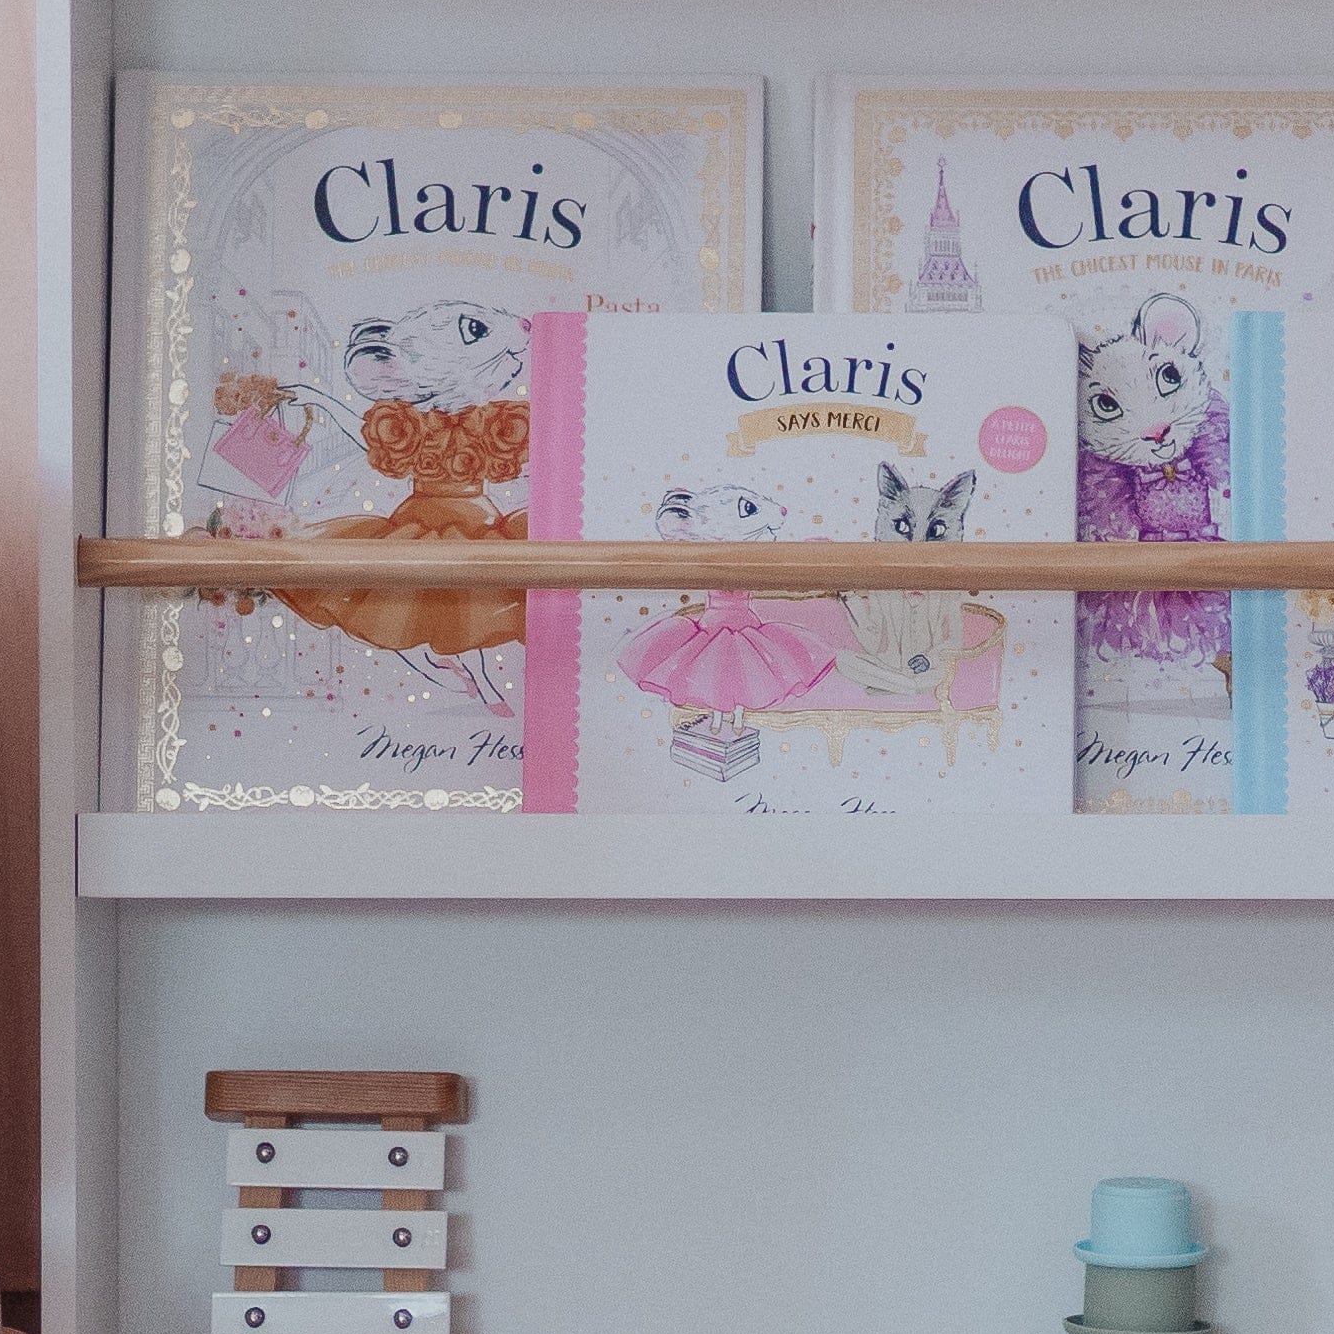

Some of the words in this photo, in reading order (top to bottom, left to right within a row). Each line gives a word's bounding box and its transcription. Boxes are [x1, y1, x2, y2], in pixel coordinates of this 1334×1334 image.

[313, 158, 588, 249] Claris
[1017, 163, 1293, 254] Claris
[1033, 264, 1064, 284] THE
[1146, 254, 1204, 273] MOUSE
[1211, 258, 1229, 276] IN
[726, 339, 929, 406] Claris
[777, 411, 821, 432] SAYS
[827, 411, 881, 432] MERCI
[356, 724, 456, 774] Megan
[1076, 731, 1170, 779] Megan
[1180, 734, 1233, 772] Hes
